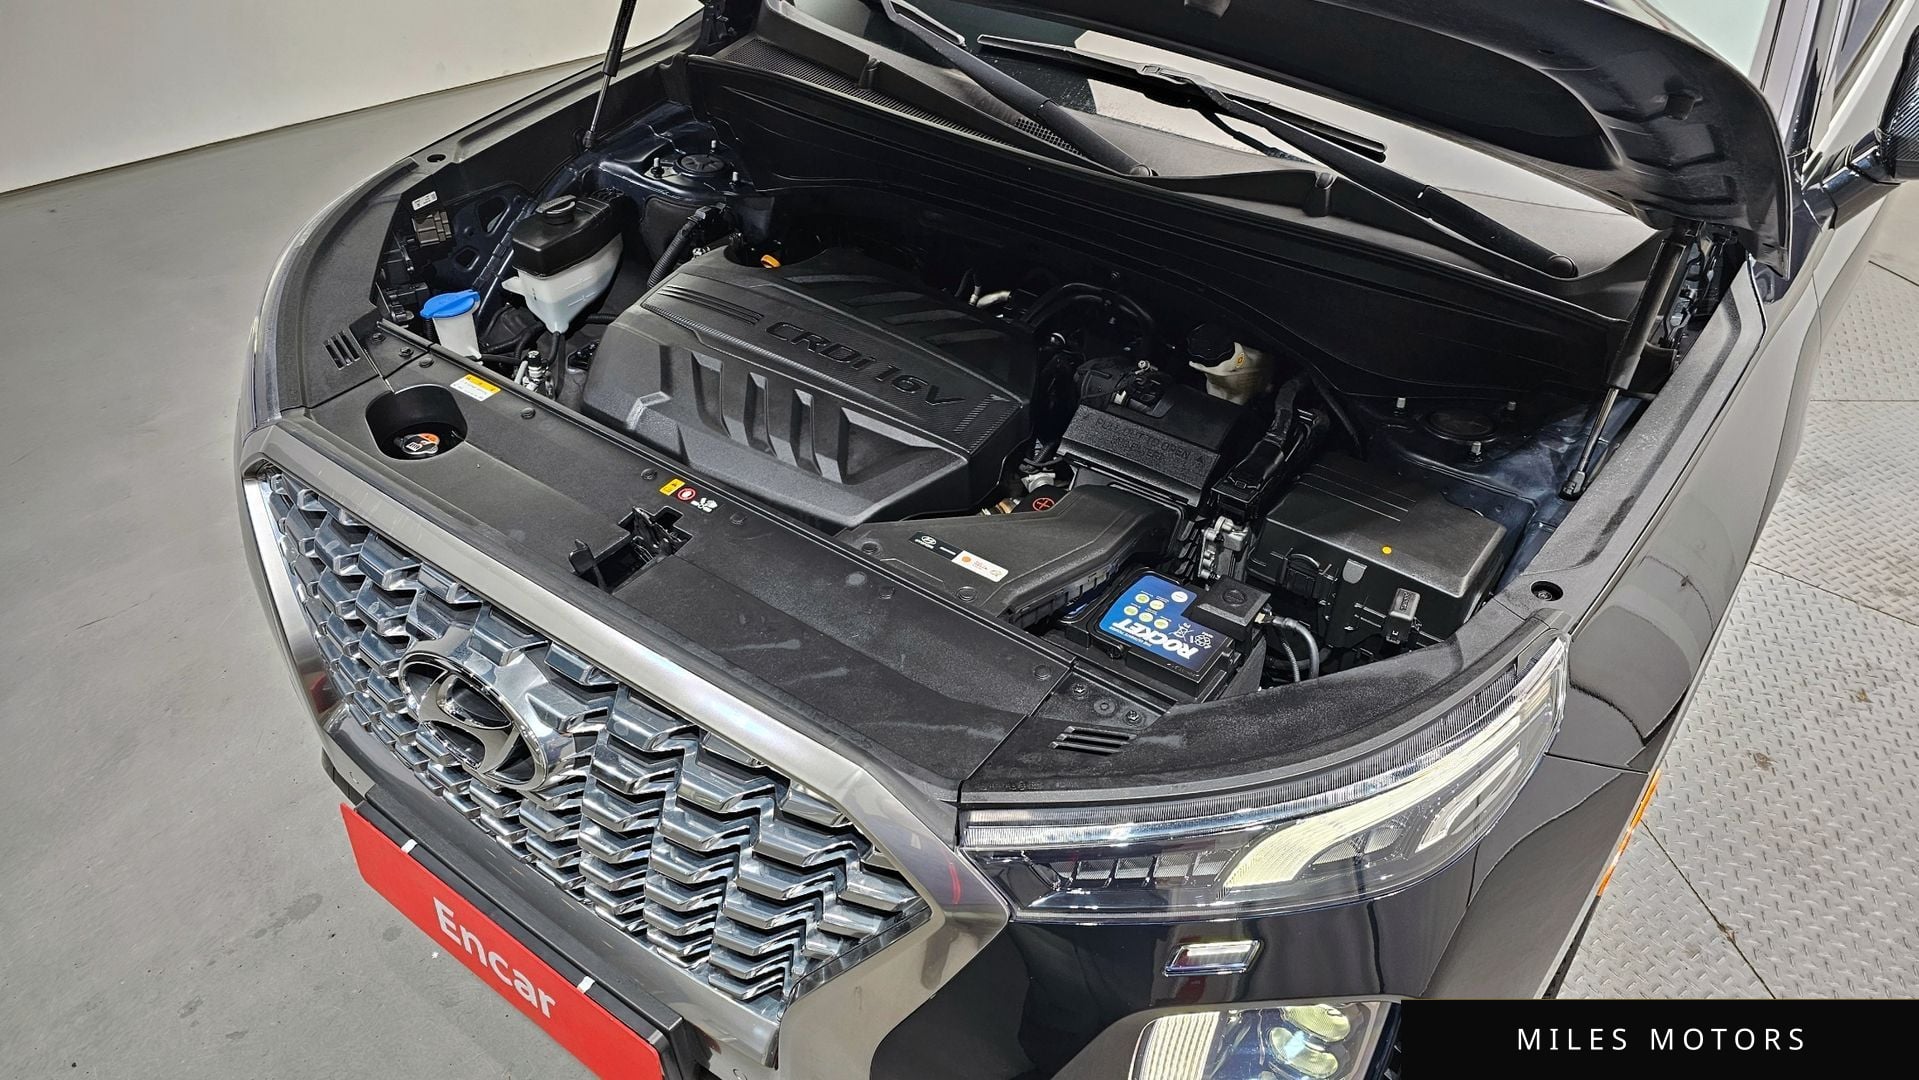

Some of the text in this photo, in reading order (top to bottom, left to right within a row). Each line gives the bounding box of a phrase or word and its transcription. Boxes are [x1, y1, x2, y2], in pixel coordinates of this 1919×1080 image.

[875, 363, 966, 405] 16V
[1160, 440, 1191, 459] OPEN
[1112, 618, 1199, 660] ROCKET
[433, 896, 556, 1019] Encar
